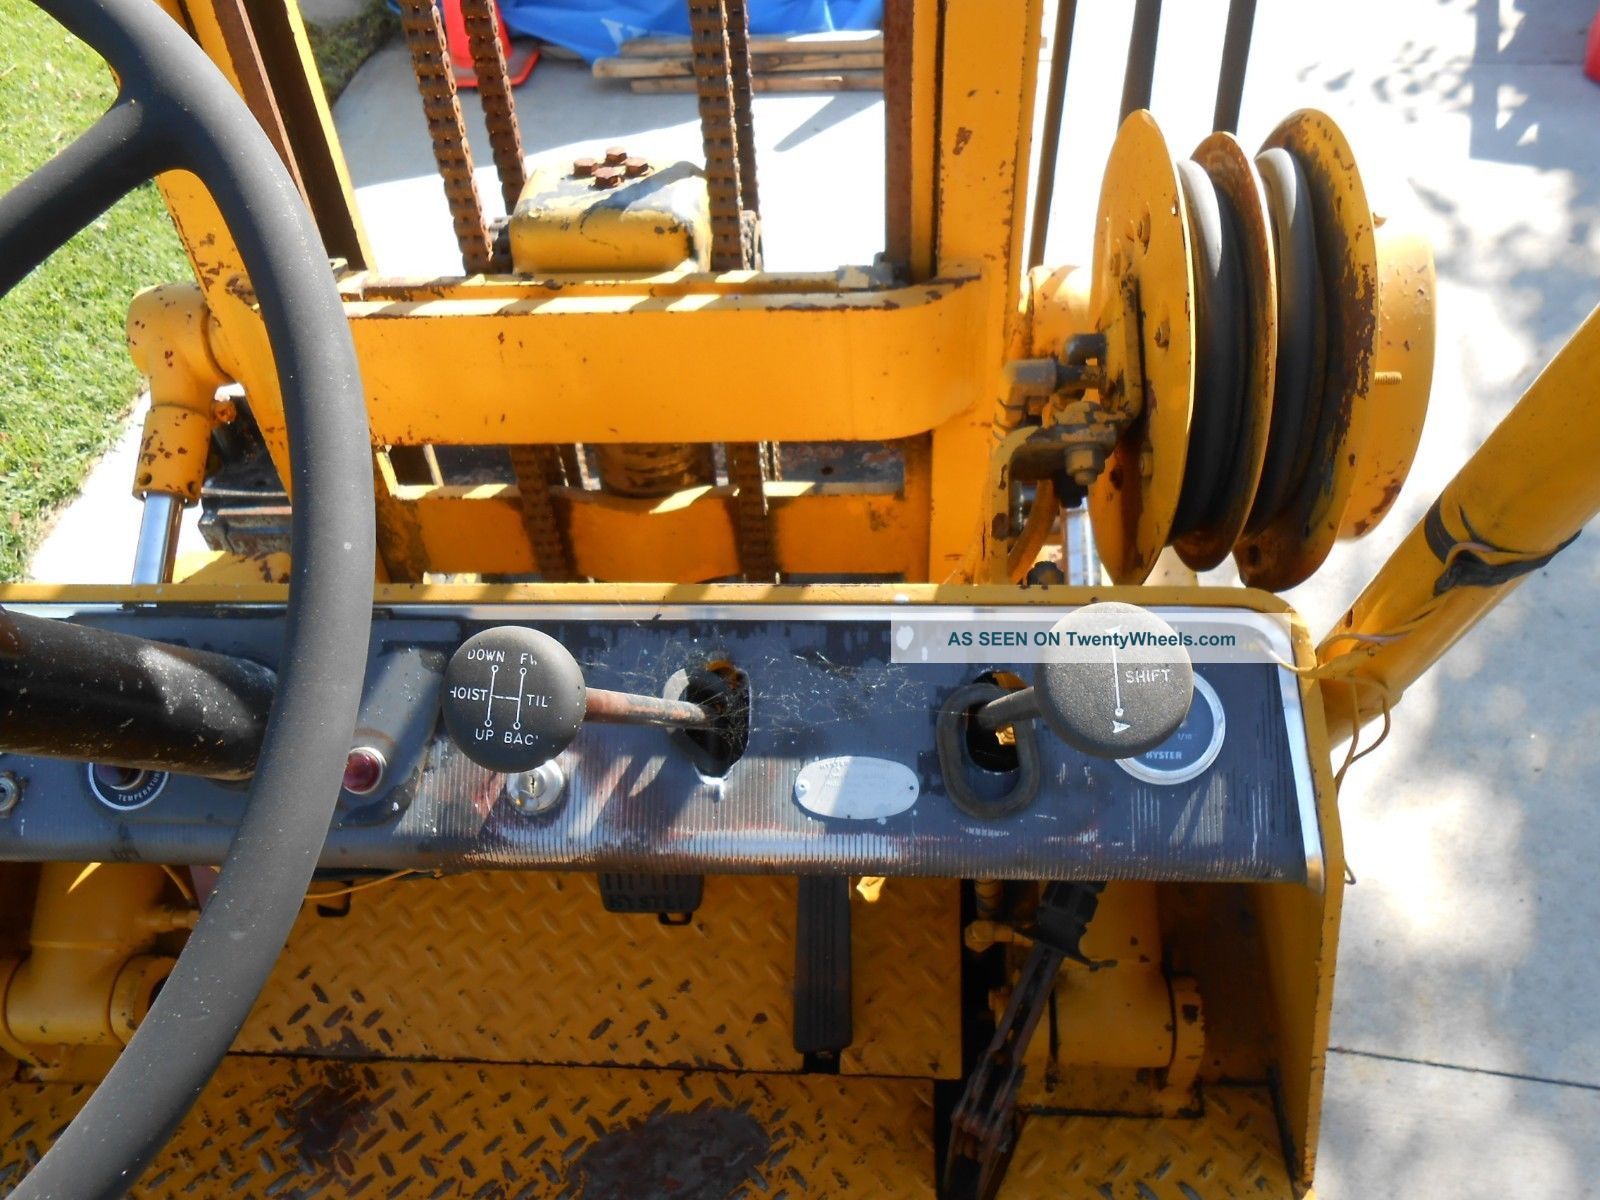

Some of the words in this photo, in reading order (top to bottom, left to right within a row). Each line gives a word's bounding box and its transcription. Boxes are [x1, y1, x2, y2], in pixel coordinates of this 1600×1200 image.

[467, 648, 505, 662] DOWN
[1125, 669, 1170, 683] SHIFT
[527, 694, 552, 708] TIL
[475, 728, 494, 741] UP
[504, 731, 539, 746] BAC
[1145, 751, 1182, 760] HYSTER
[118, 771, 161, 802] TEMPERATUR
